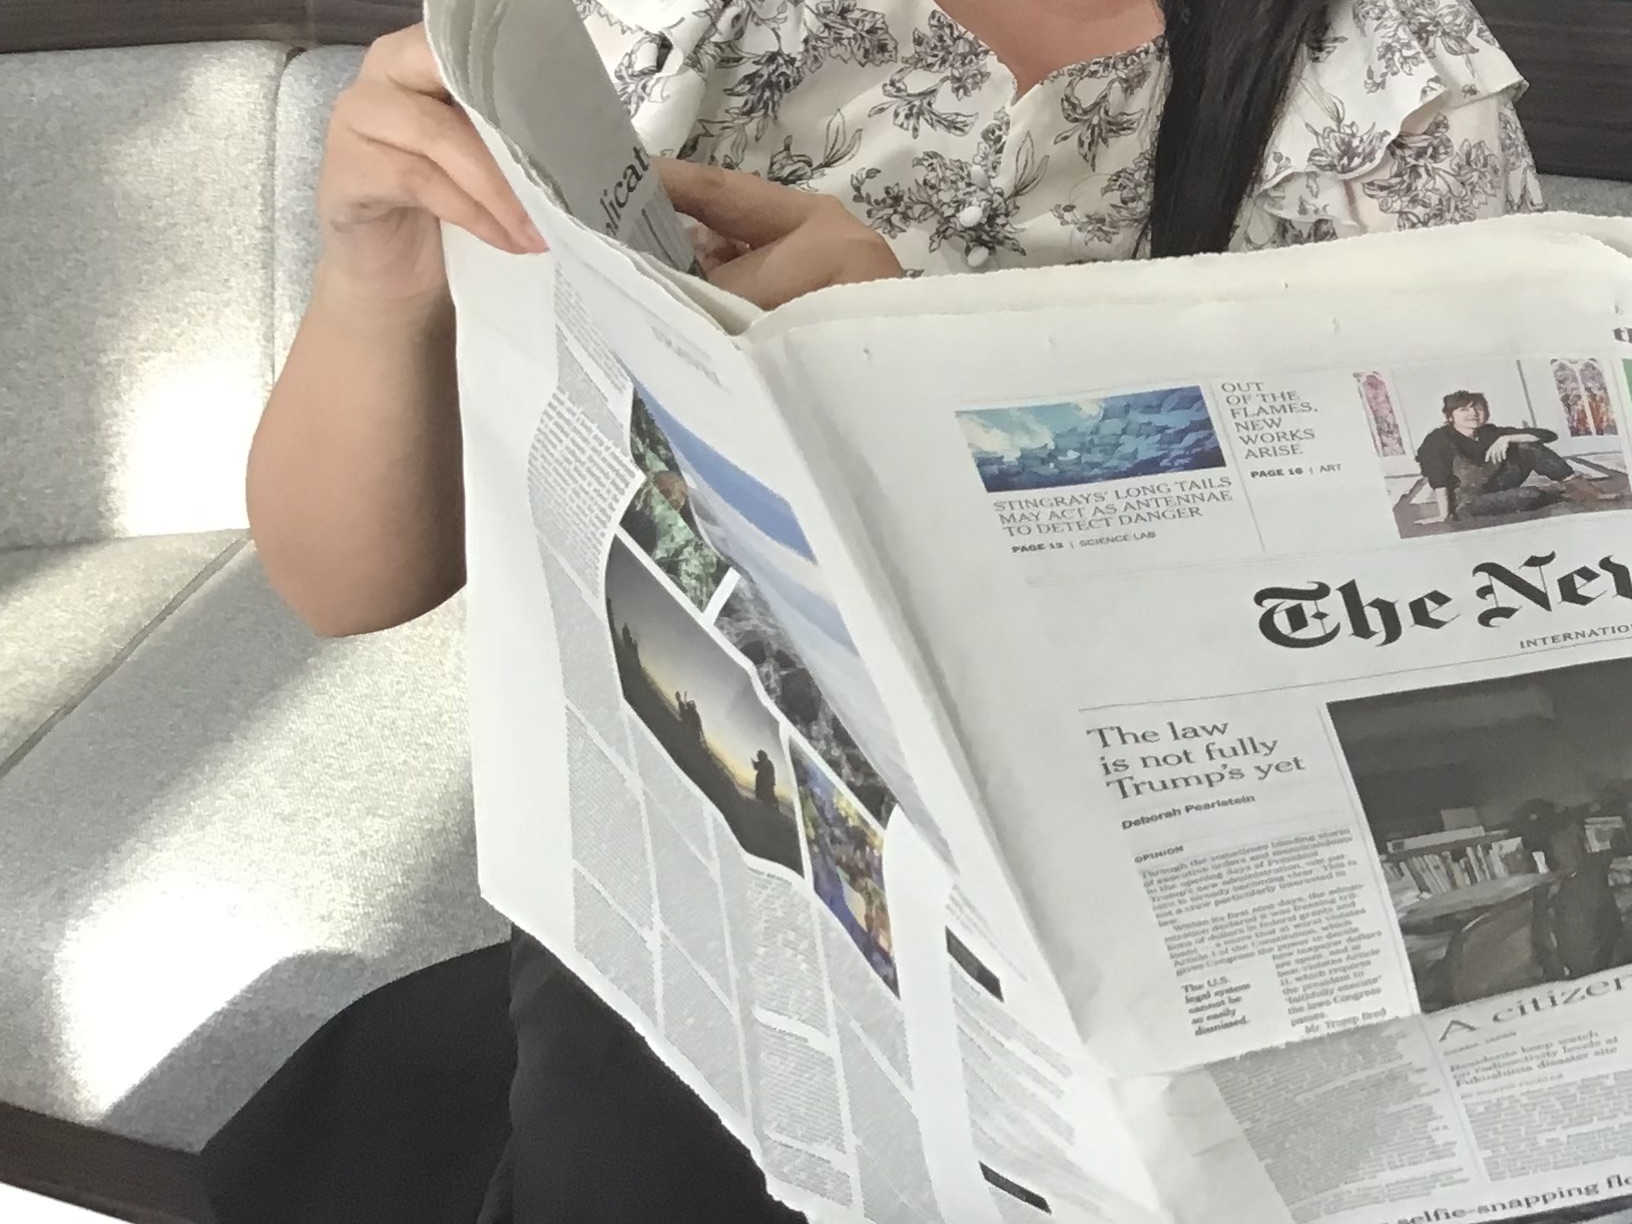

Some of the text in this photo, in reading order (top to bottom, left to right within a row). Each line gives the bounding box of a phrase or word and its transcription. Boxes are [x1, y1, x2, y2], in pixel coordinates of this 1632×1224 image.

[1221, 380, 1265, 394] OUT
[1225, 390, 1300, 406] OF THE
[1234, 416, 1282, 432] NEW
[1238, 428, 1316, 446] WORKS
[1244, 444, 1303, 460] ARISE
[1250, 467, 1285, 479] PAGE
[1319, 463, 1343, 474] ART
[1114, 482, 1171, 500] LONG
[1174, 475, 1233, 494] TAILS
[999, 490, 1233, 526] MAY ACT AS ANTENNAE
[1003, 505, 1203, 538] TO DETECT DANGER
[1011, 542, 1046, 554] PAGE
[1079, 534, 1129, 548] SCIENCE
[1133, 531, 1157, 541] LAB
[1253, 579, 1454, 651] The
[1087, 721, 1229, 748] The law
[1100, 736, 1279, 775] is not fully
[1254, 756, 1306, 780] yet
[1121, 806, 1182, 830] Deborah
[1133, 845, 1184, 863] OPINION
[1438, 1019, 1478, 1043] A
